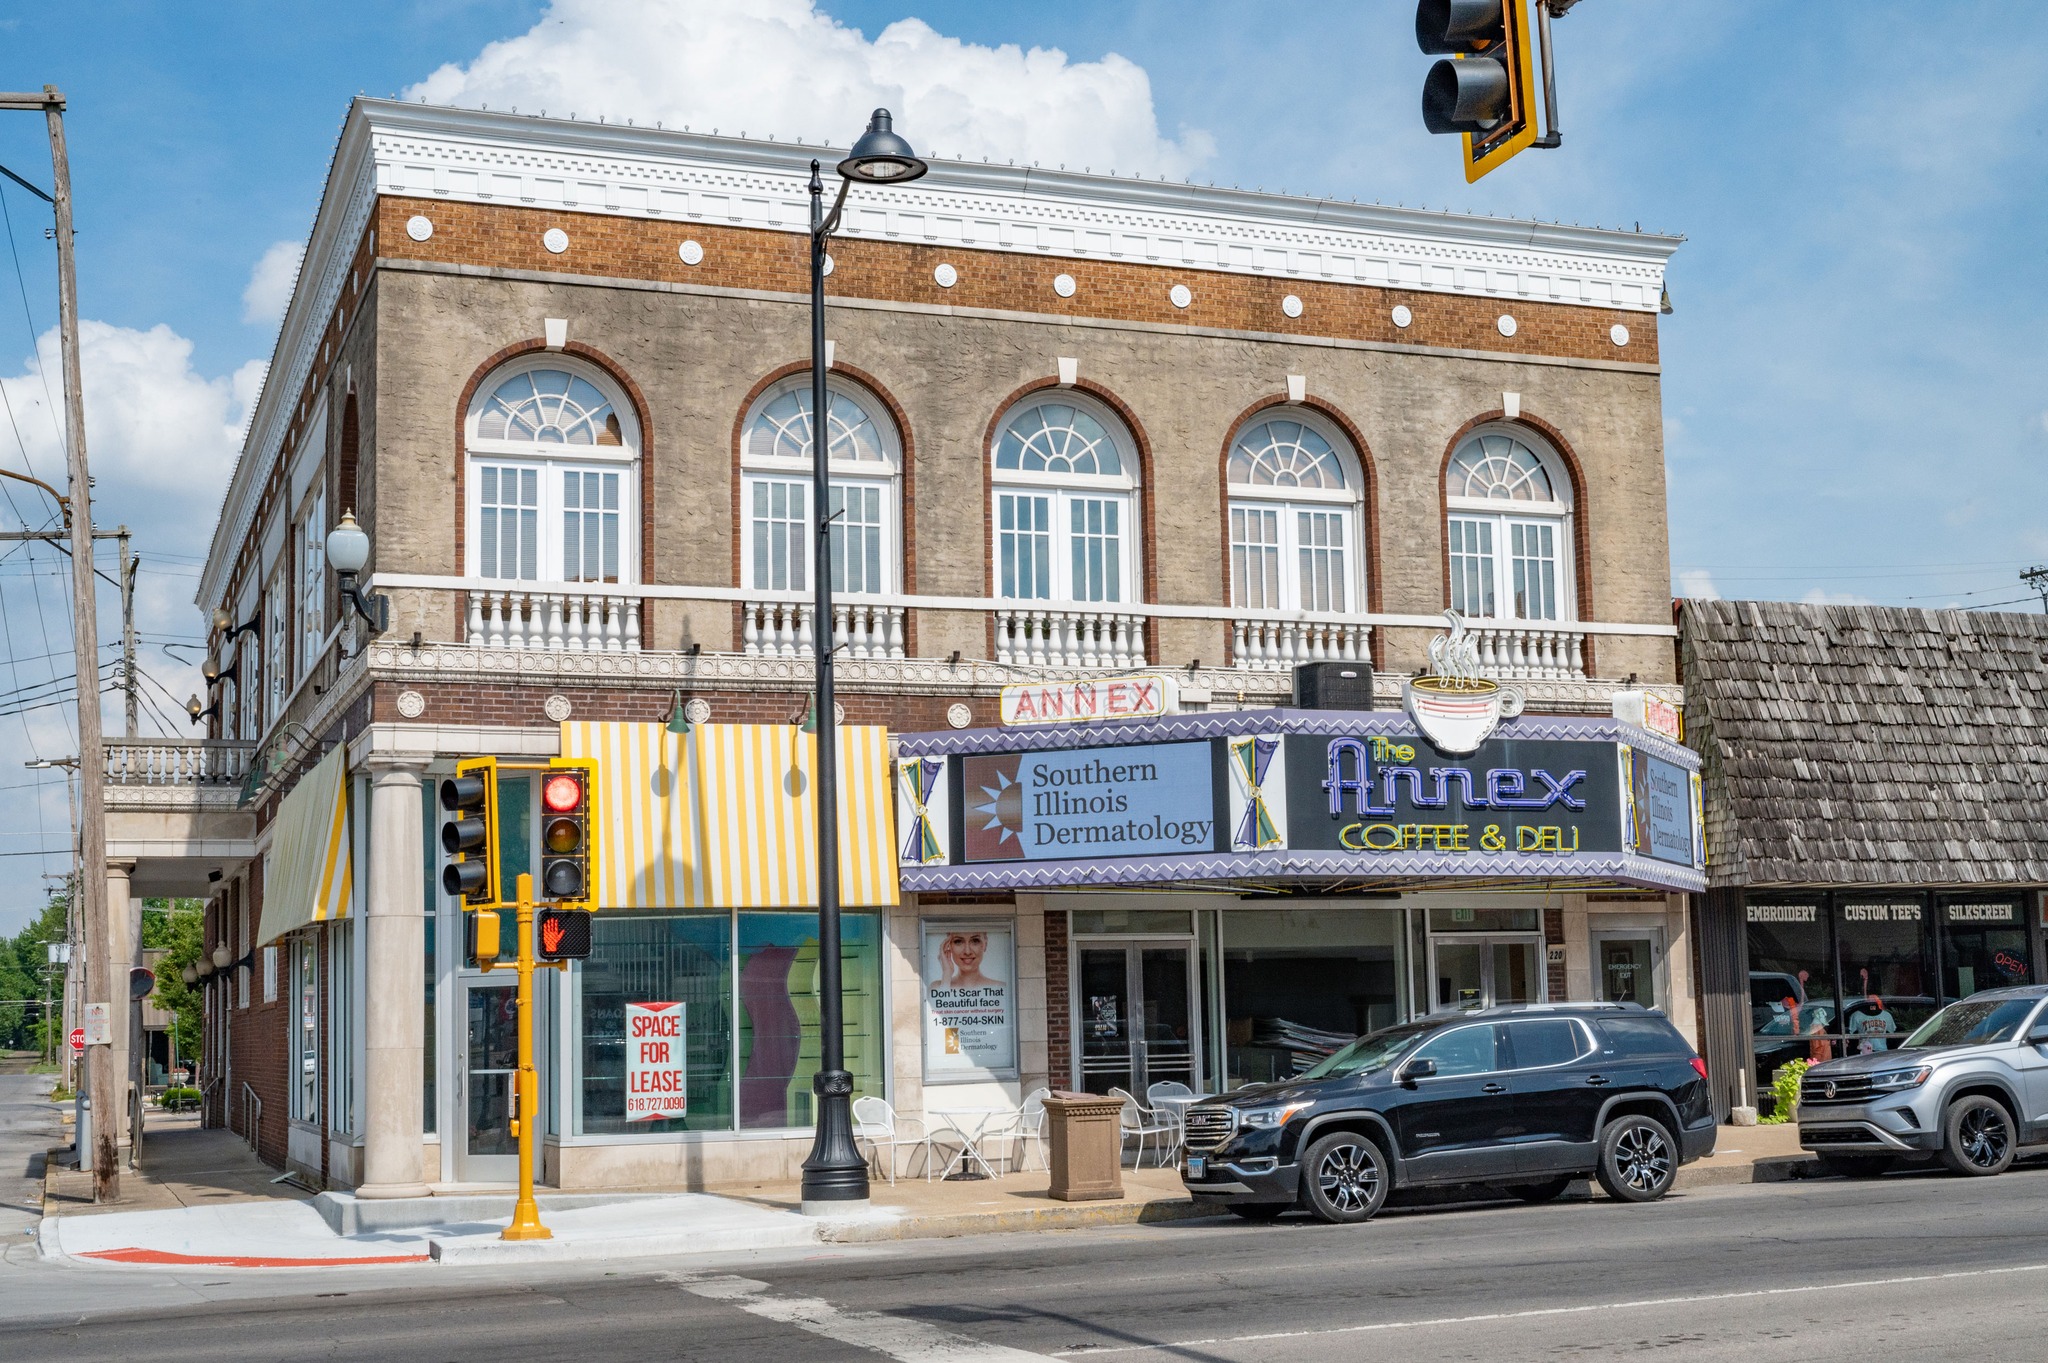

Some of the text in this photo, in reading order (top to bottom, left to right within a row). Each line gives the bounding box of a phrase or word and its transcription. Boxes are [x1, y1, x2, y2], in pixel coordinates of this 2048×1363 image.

[1014, 681, 1155, 719] ANNEX
[1367, 736, 1416, 763] The
[1032, 759, 1159, 788] Southern
[1321, 737, 1587, 816] Annex
[1650, 768, 1679, 799] Southern
[1033, 788, 1128, 817] Illinois
[1652, 795, 1674, 823] Illinois
[1033, 815, 1214, 846] Dermatology
[1338, 823, 1579, 852] COFFEE & DELI
[1652, 823, 1691, 859] Dermatology
[1455, 908, 1471, 920] EXIT
[1746, 905, 1817, 922] EMBROIDERY
[1844, 904, 1922, 921] CUSTOM TEE'S
[1949, 904, 2013, 921] SILKSCREEN
[1549, 950, 1563, 960] 220
[1994, 952, 2028, 976] OPEN
[930, 987, 1004, 998] Don't Scar That
[935, 998, 1000, 1008] Beautiful face
[632, 1015, 681, 1038] SPACE
[933, 1015, 1005, 1027] 1-877-504-SKIN
[70, 1034, 84, 1044] STO
[960, 1043, 998, 1051] Dermatology
[640, 1042, 670, 1064] FOR
[630, 1070, 683, 1093] LEASE
[627, 1096, 686, 1111] 618.727.0090
